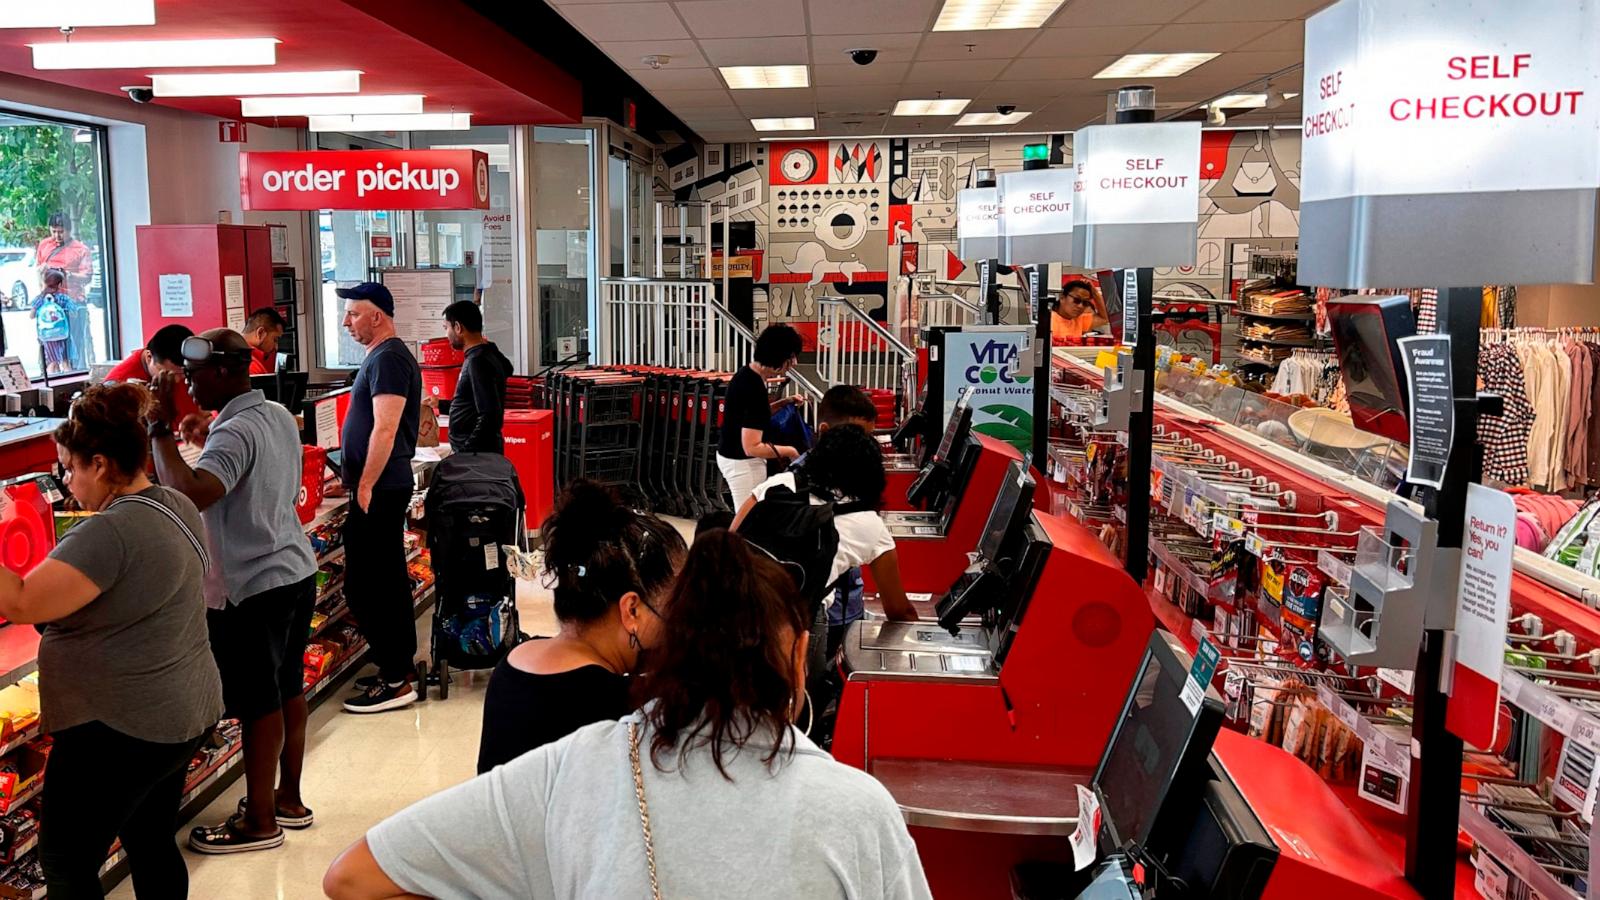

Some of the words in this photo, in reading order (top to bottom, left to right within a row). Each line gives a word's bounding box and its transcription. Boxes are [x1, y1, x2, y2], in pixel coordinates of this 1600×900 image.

[1447, 53, 1532, 80] SELF
[1320, 71, 1342, 100] SELF
[1390, 91, 1584, 121] CHECKOUT
[1126, 158, 1164, 171] SELF
[262, 163, 346, 192] order
[358, 161, 460, 198] pickup
[1100, 175, 1188, 190] CHECKOUT
[1030, 192, 1055, 201] SELF
[1013, 202, 1071, 214] CHECKOUT
[483, 214, 505, 222] Avoid
[483, 223, 502, 231] Fees
[712, 263, 750, 271] SEURITY
[970, 339, 1018, 364] VITA
[1412, 347, 1434, 357] Fraud
[1004, 387, 1034, 395] Wate
[1470, 516, 1495, 536] Return
[1497, 526, 1508, 539] it?
[1469, 530, 1484, 547] Yes,
[1485, 538, 1499, 552] you
